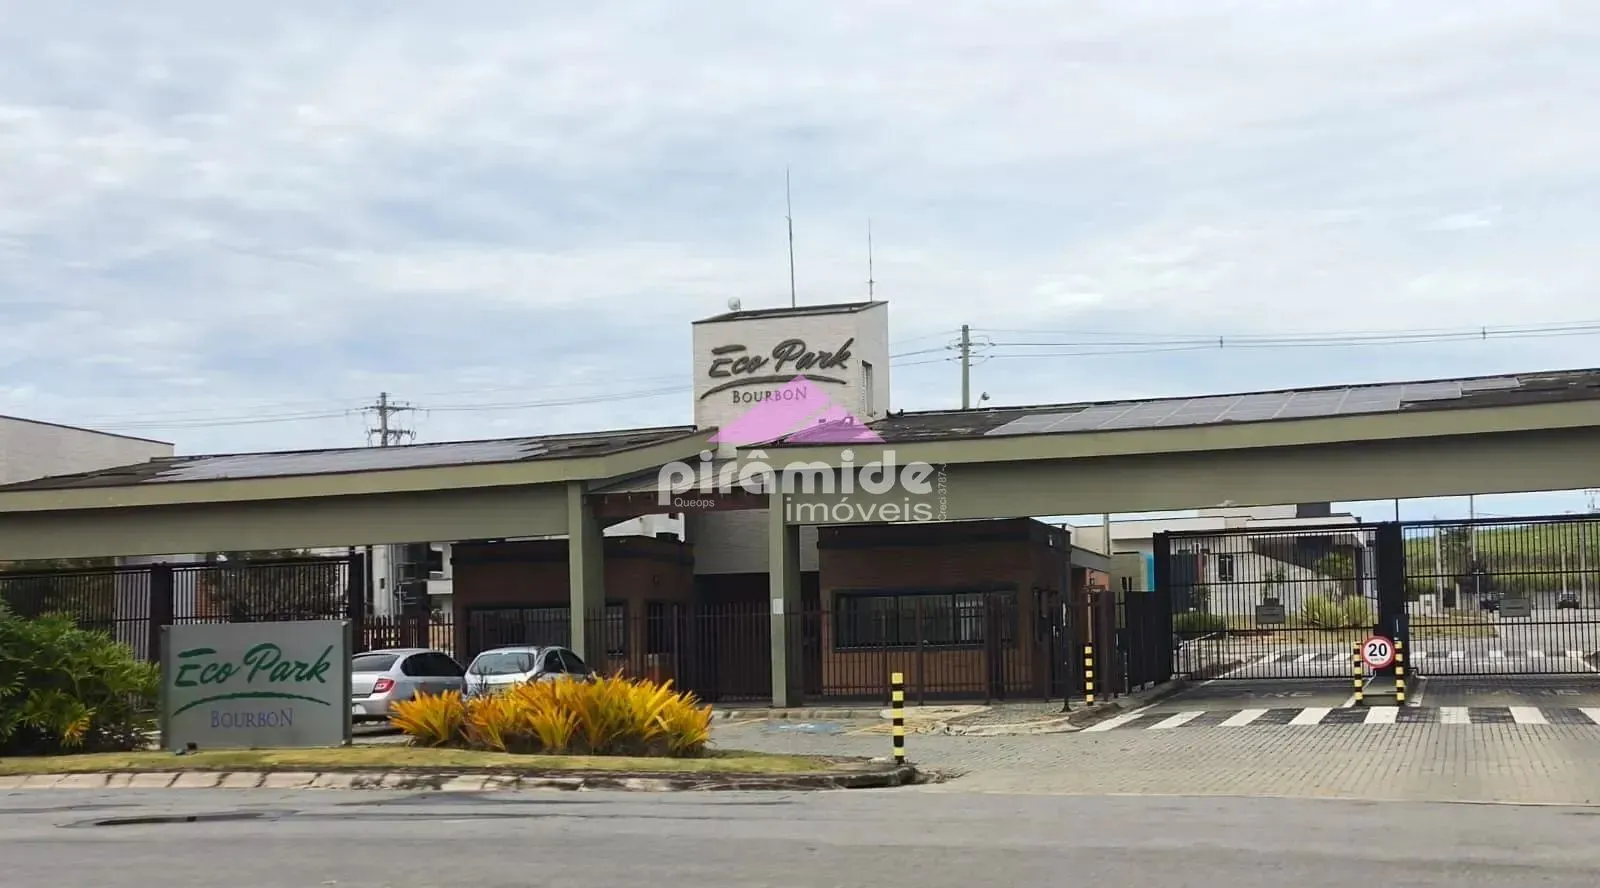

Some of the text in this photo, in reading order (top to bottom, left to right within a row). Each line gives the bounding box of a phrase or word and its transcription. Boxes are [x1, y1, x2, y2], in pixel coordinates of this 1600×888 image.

[708, 338, 855, 377] Eco Park
[732, 387, 807, 404] BOURBON
[1368, 643, 1388, 657] 20
[174, 643, 334, 687] Eco Park
[211, 708, 293, 728] BOURBON
